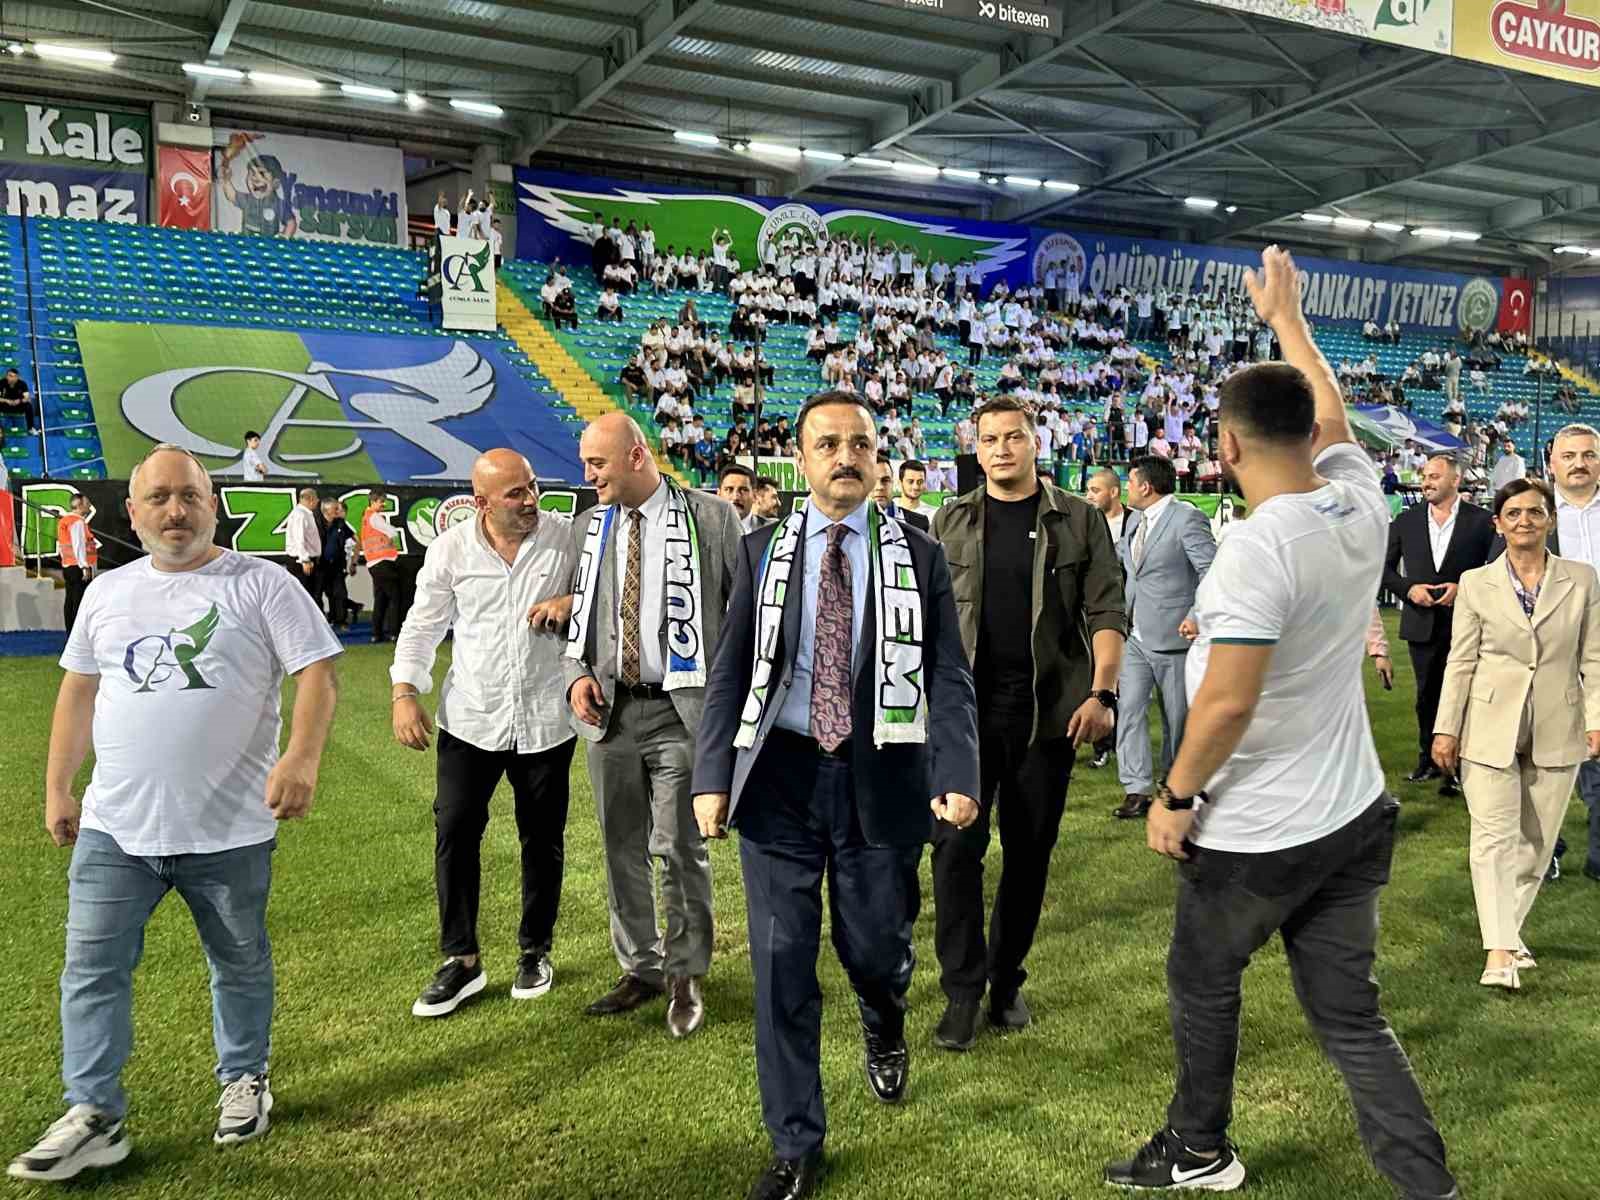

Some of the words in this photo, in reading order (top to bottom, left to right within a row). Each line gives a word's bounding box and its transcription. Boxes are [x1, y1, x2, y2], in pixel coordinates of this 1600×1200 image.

[999, 5, 1049, 29] bitexen
[1499, 11, 1600, 61] ÇAYKUR
[24, 104, 145, 164] Kale
[5, 179, 138, 225] maz
[1388, 280, 1458, 328] YETMEZ
